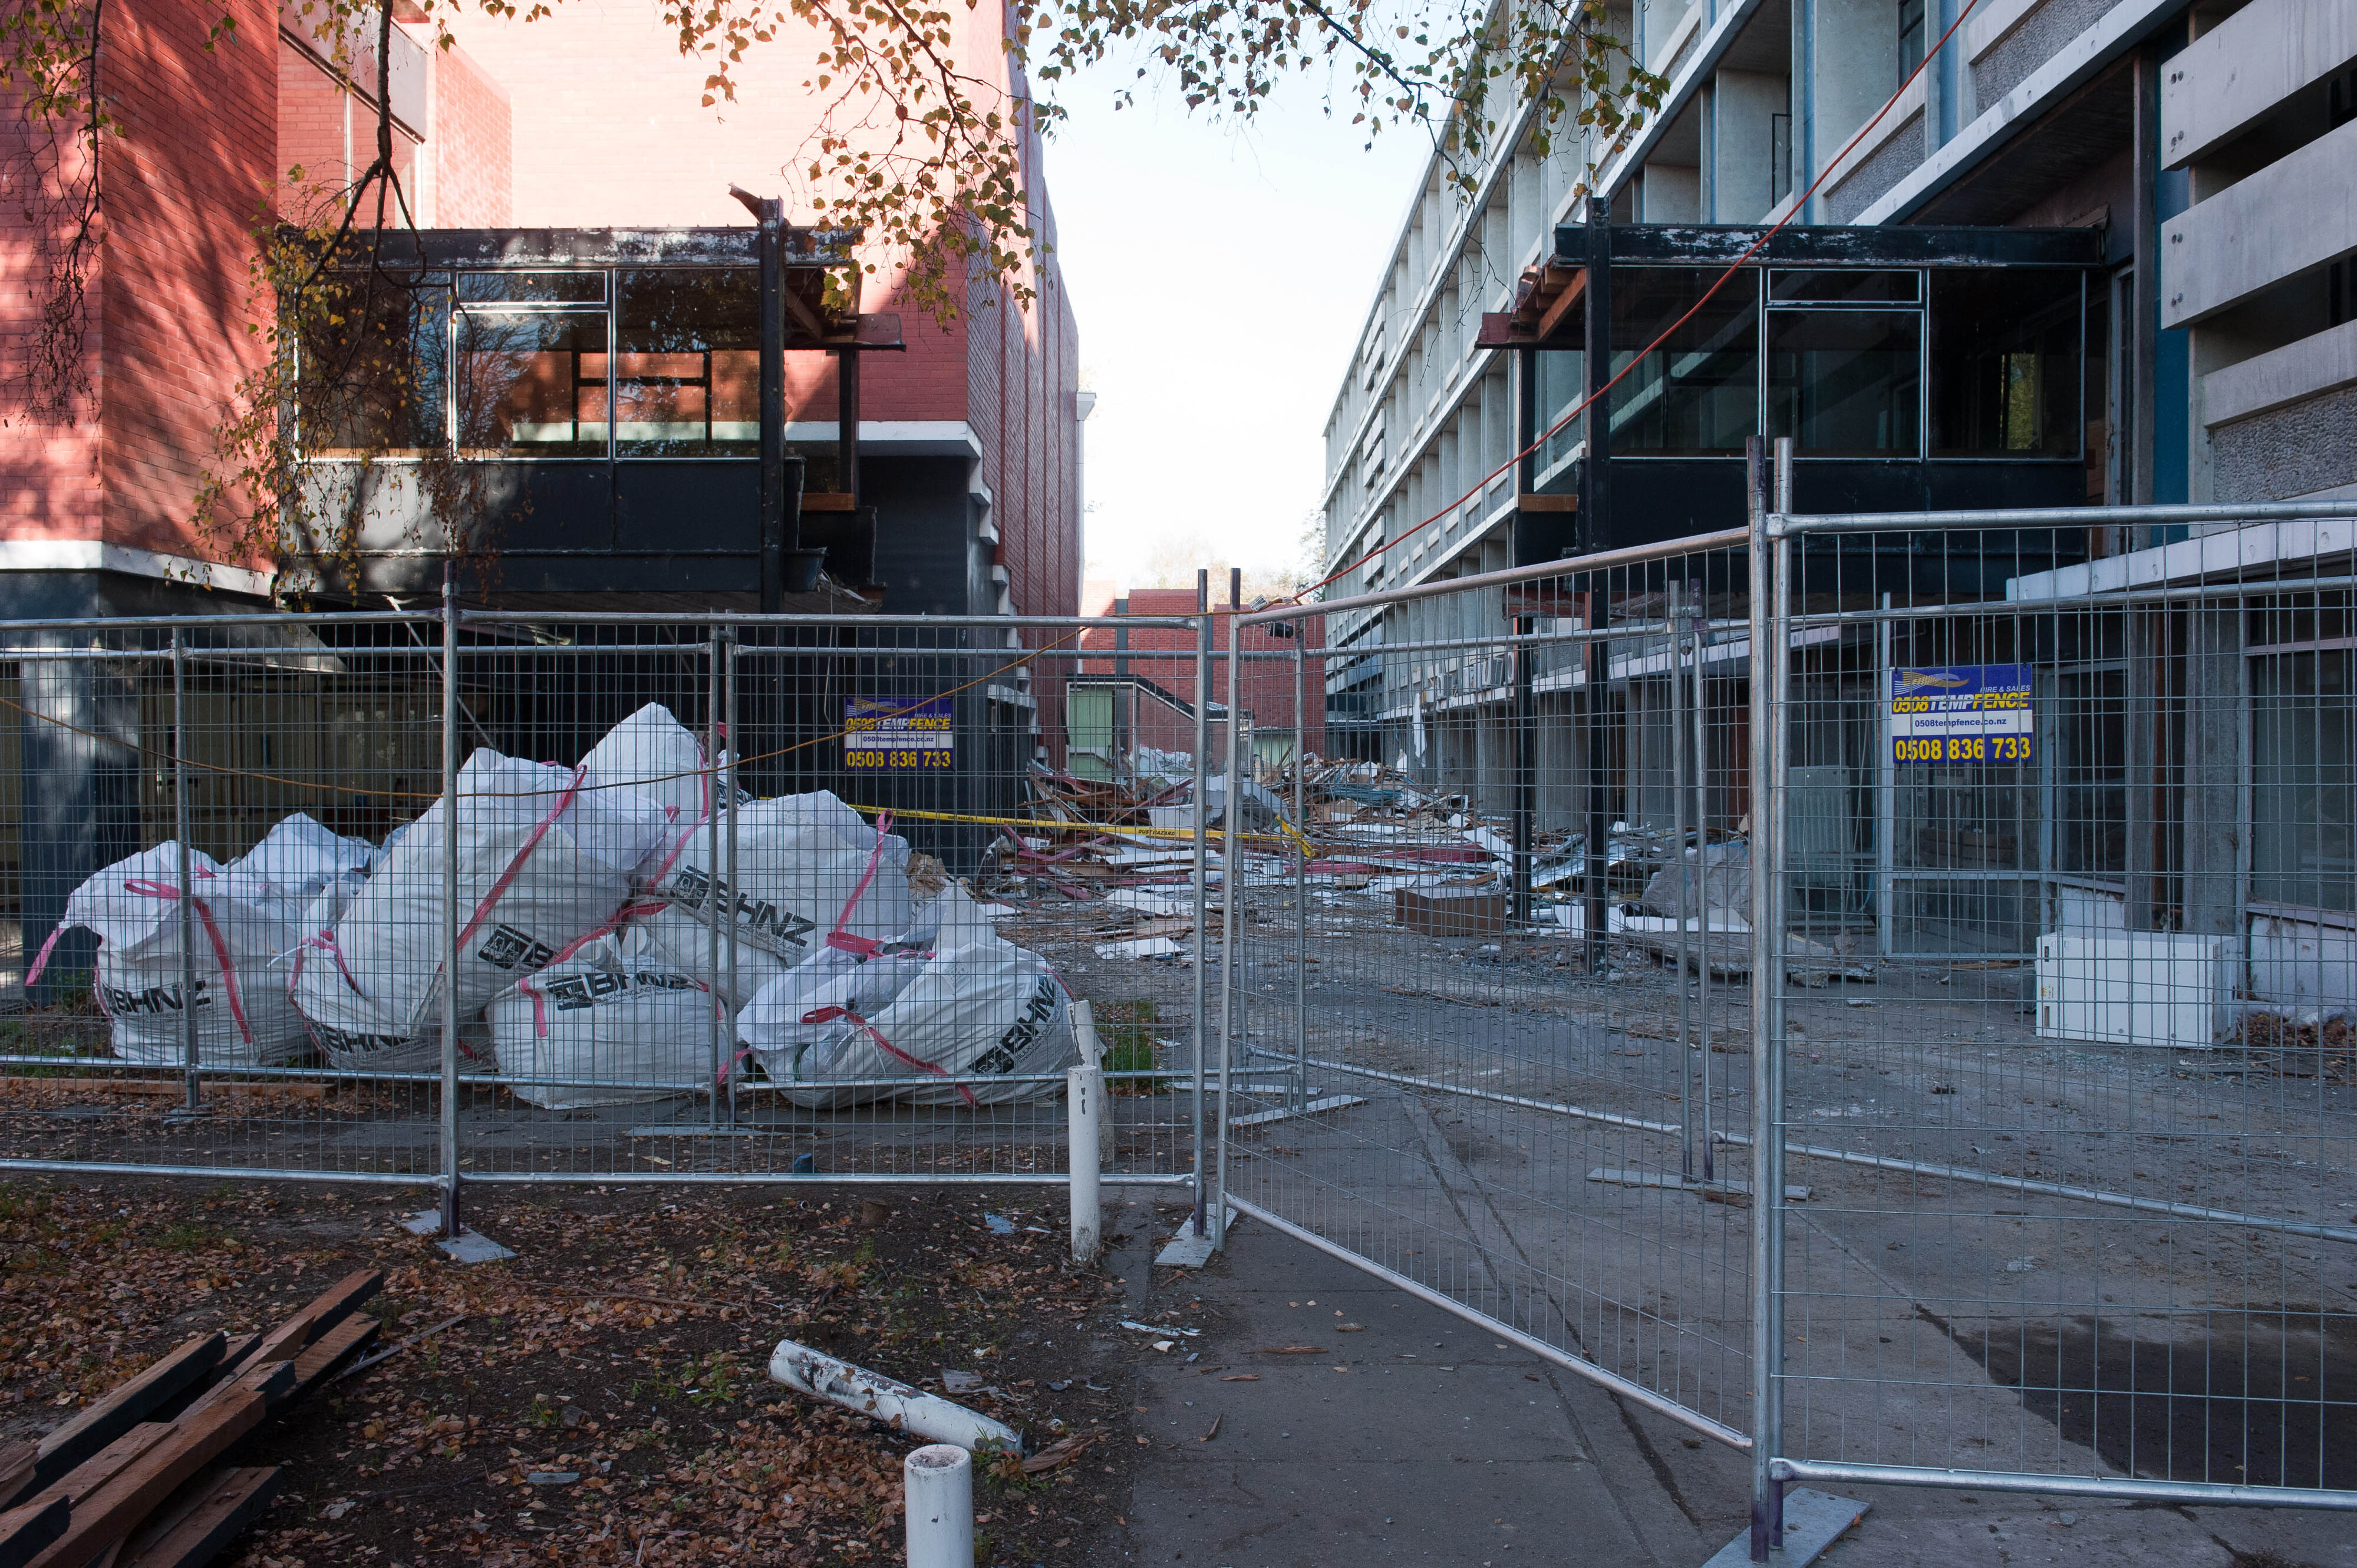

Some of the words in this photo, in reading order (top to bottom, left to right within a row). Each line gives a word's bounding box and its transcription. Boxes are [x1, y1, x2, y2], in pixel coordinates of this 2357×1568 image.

[1915, 718, 2007, 728] 0508tempfence.co.nz
[1896, 739, 1942, 761] 0508
[1949, 738, 1984, 760] 836
[1992, 737, 2031, 759] 733
[846, 751, 884, 767] 0508
[889, 751, 917, 767] 836
[923, 751, 951, 767] 733
